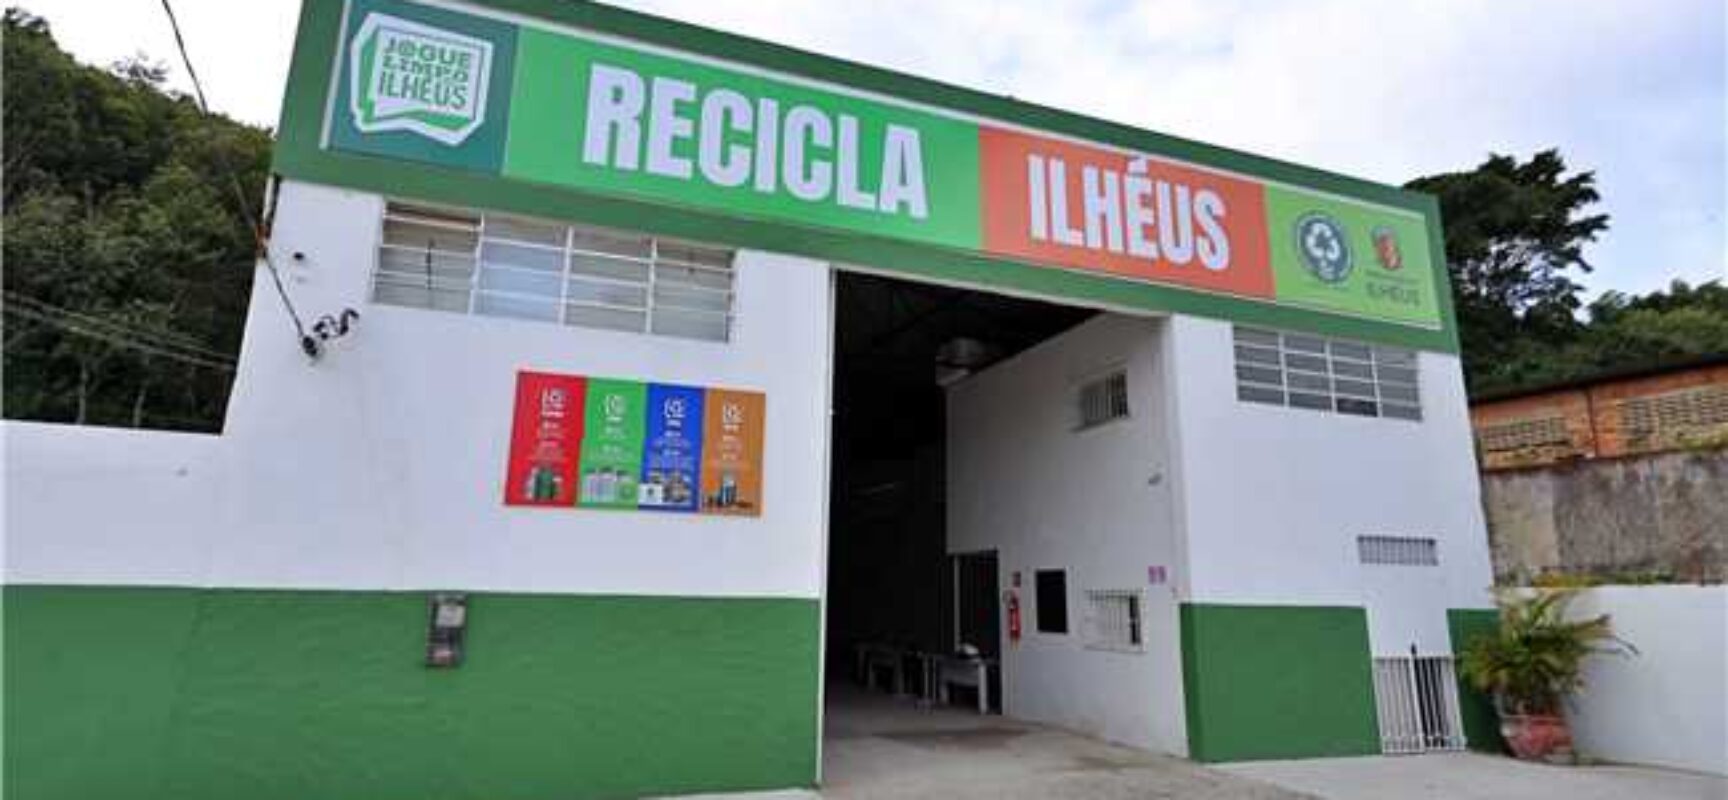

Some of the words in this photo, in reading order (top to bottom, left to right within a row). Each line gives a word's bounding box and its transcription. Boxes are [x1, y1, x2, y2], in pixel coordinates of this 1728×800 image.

[384, 38, 471, 69] JOGUE
[582, 62, 928, 219] RECICLA
[1028, 153, 1230, 271] ILHÉUS
